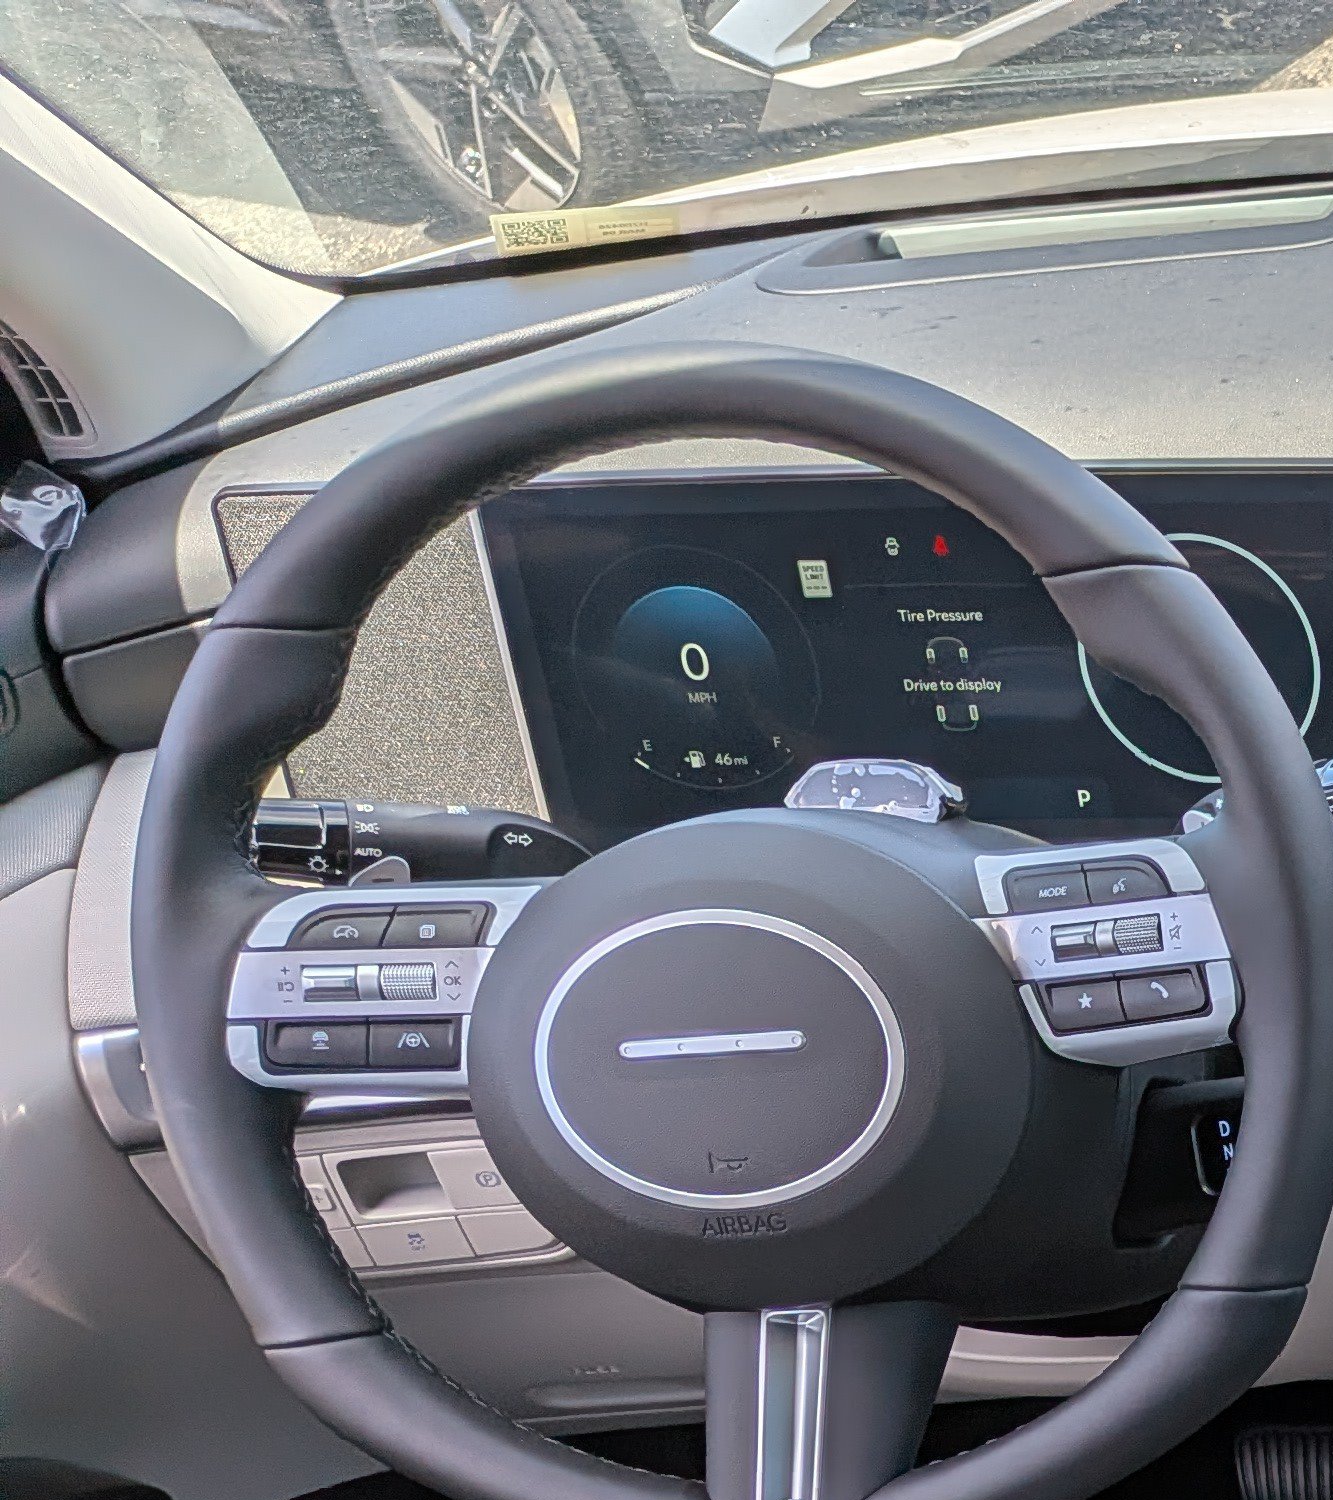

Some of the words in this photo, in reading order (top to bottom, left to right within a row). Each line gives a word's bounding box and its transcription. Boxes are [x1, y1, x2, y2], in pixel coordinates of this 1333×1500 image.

[802, 565, 824, 573] SPEED
[897, 609, 924, 622] Tire
[927, 609, 983, 621] Pressure
[681, 643, 709, 681] 0
[903, 679, 938, 692] Drive
[940, 680, 954, 691] to
[956, 678, 1001, 693] display
[688, 691, 717, 703] MPH
[642, 740, 652, 751] E
[773, 736, 781, 748] F
[715, 753, 733, 766] 46
[734, 755, 748, 766] mi
[1077, 789, 1090, 807] P
[353, 847, 382, 858] AUTO
[1038, 885, 1068, 898] MODE
[443, 975, 462, 986] OK
[1218, 1120, 1231, 1137] D
[1222, 1142, 1234, 1161] N
[701, 1212, 788, 1237] AIRBAG
